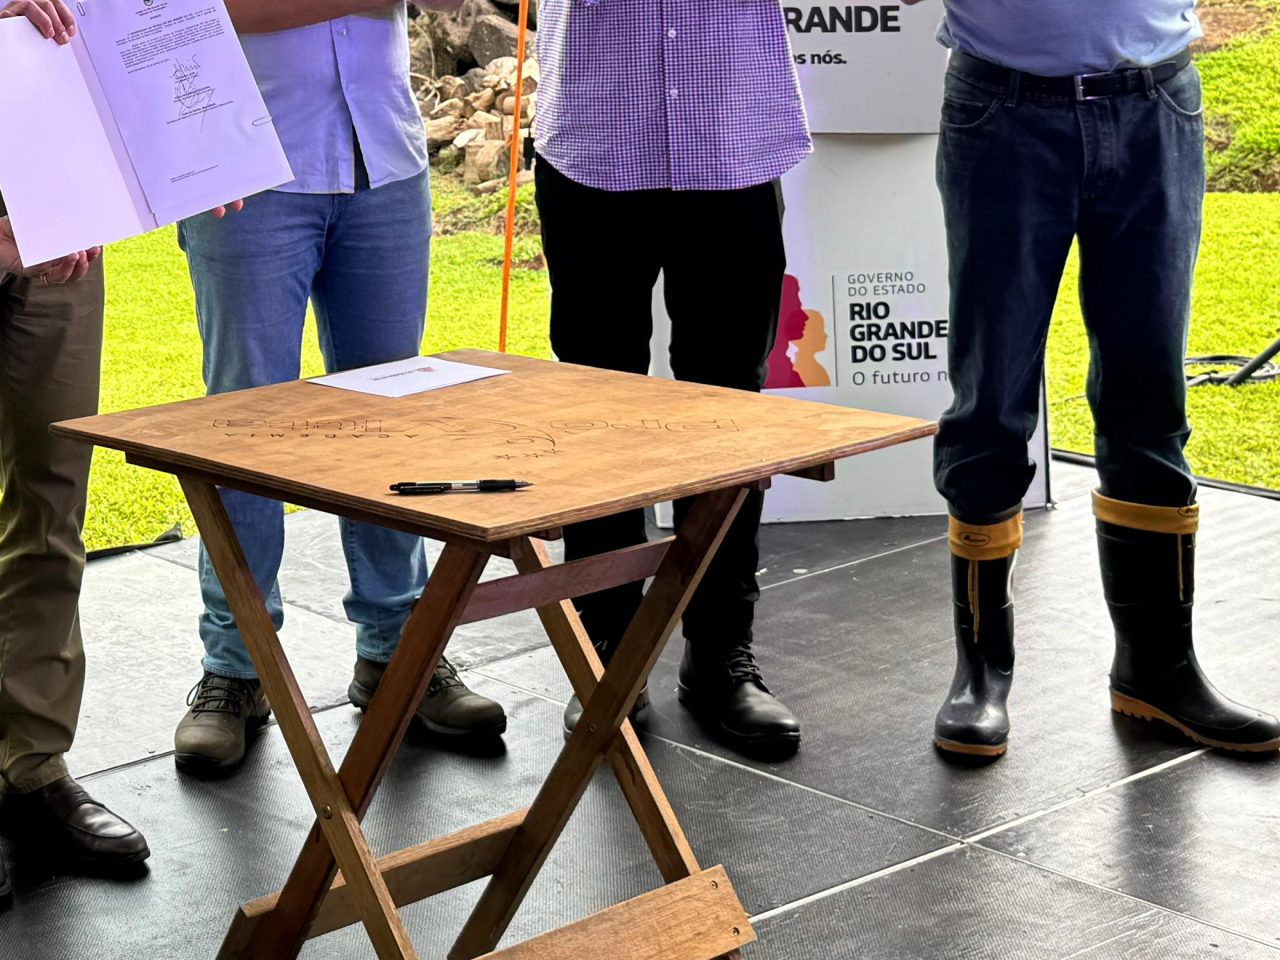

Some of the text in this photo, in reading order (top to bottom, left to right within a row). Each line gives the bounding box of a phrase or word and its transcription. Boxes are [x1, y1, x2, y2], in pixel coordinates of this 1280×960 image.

[783, 5, 901, 33] RANDE
[810, 49, 847, 65] nós.
[847, 271, 914, 284] GOVERNO
[848, 283, 926, 297] DO ESTADO
[849, 301, 890, 321] RIO
[849, 320, 949, 342] GRANDE
[851, 341, 937, 363] DO SUL
[852, 371, 865, 386] O
[872, 370, 930, 385] futuro
